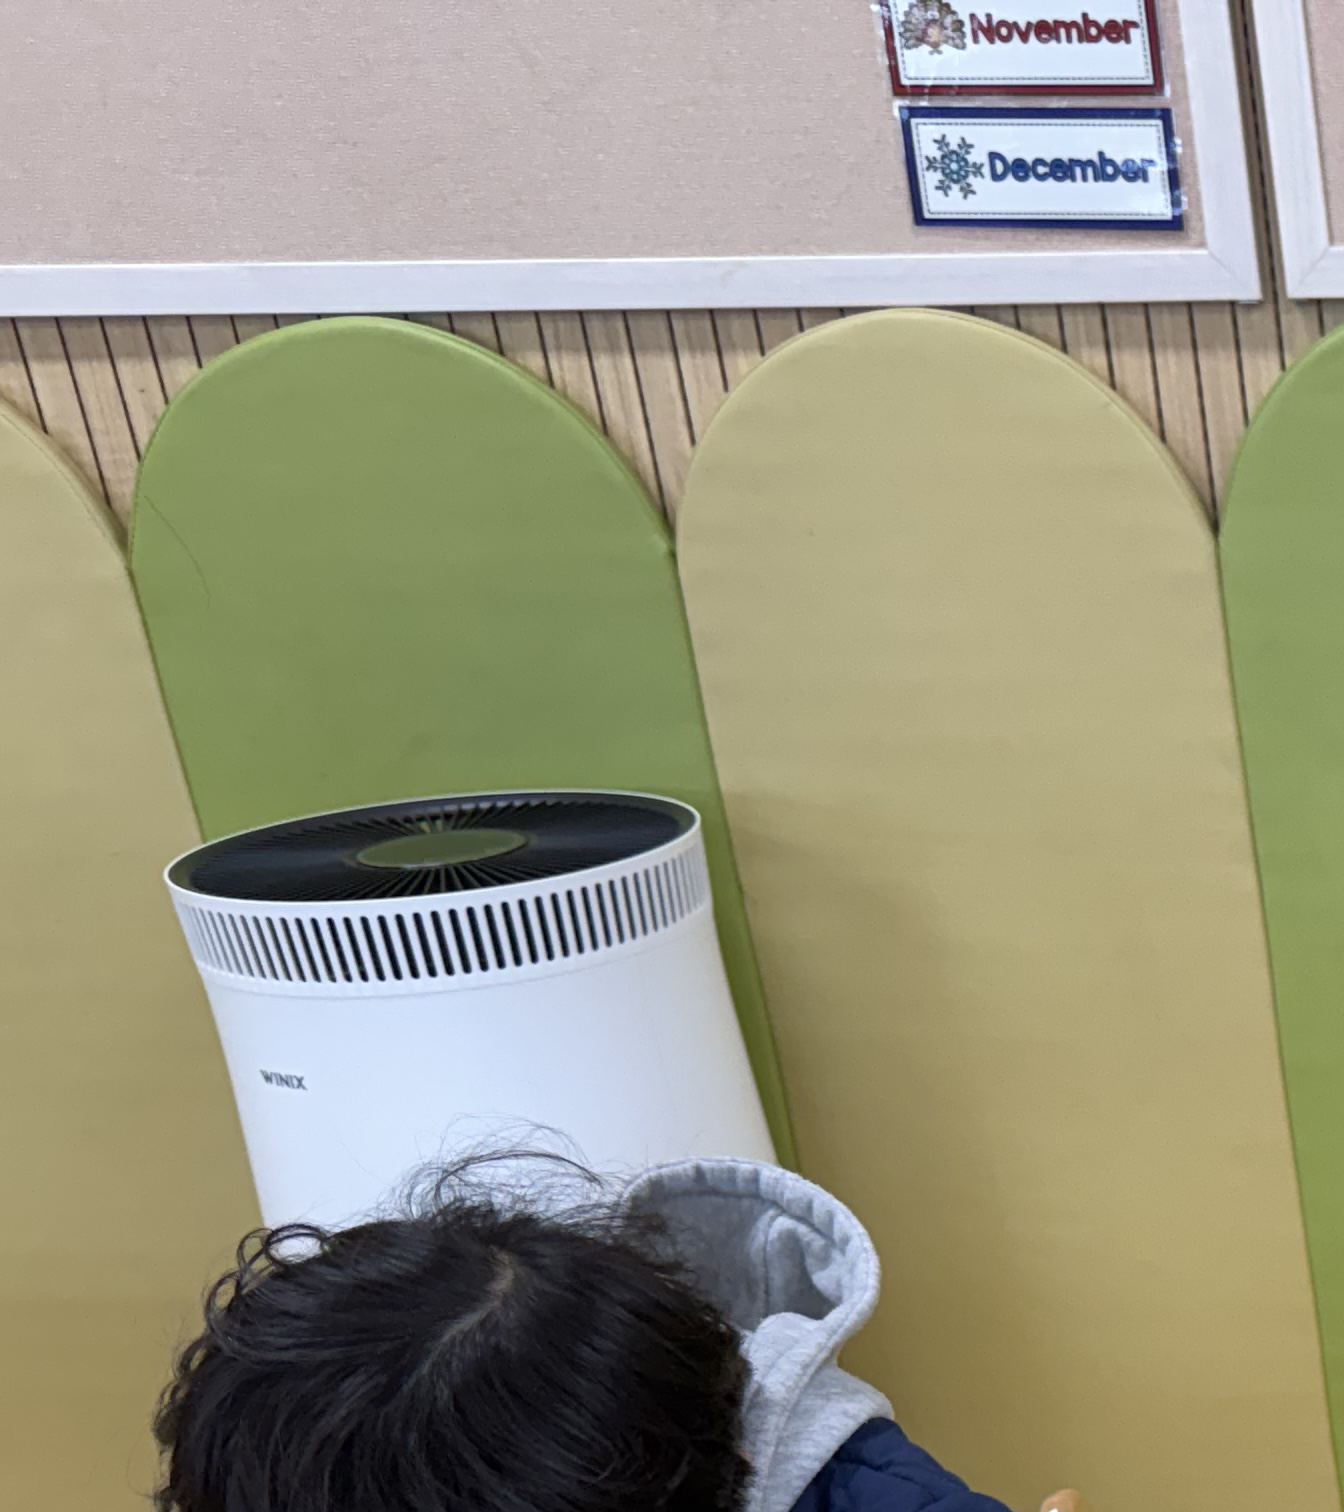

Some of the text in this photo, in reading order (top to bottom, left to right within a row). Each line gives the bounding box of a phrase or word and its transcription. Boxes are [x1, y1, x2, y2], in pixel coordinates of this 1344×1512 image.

[970, 12, 1141, 45] November
[987, 150, 1156, 184] December
[259, 1069, 308, 1091] WINIX
